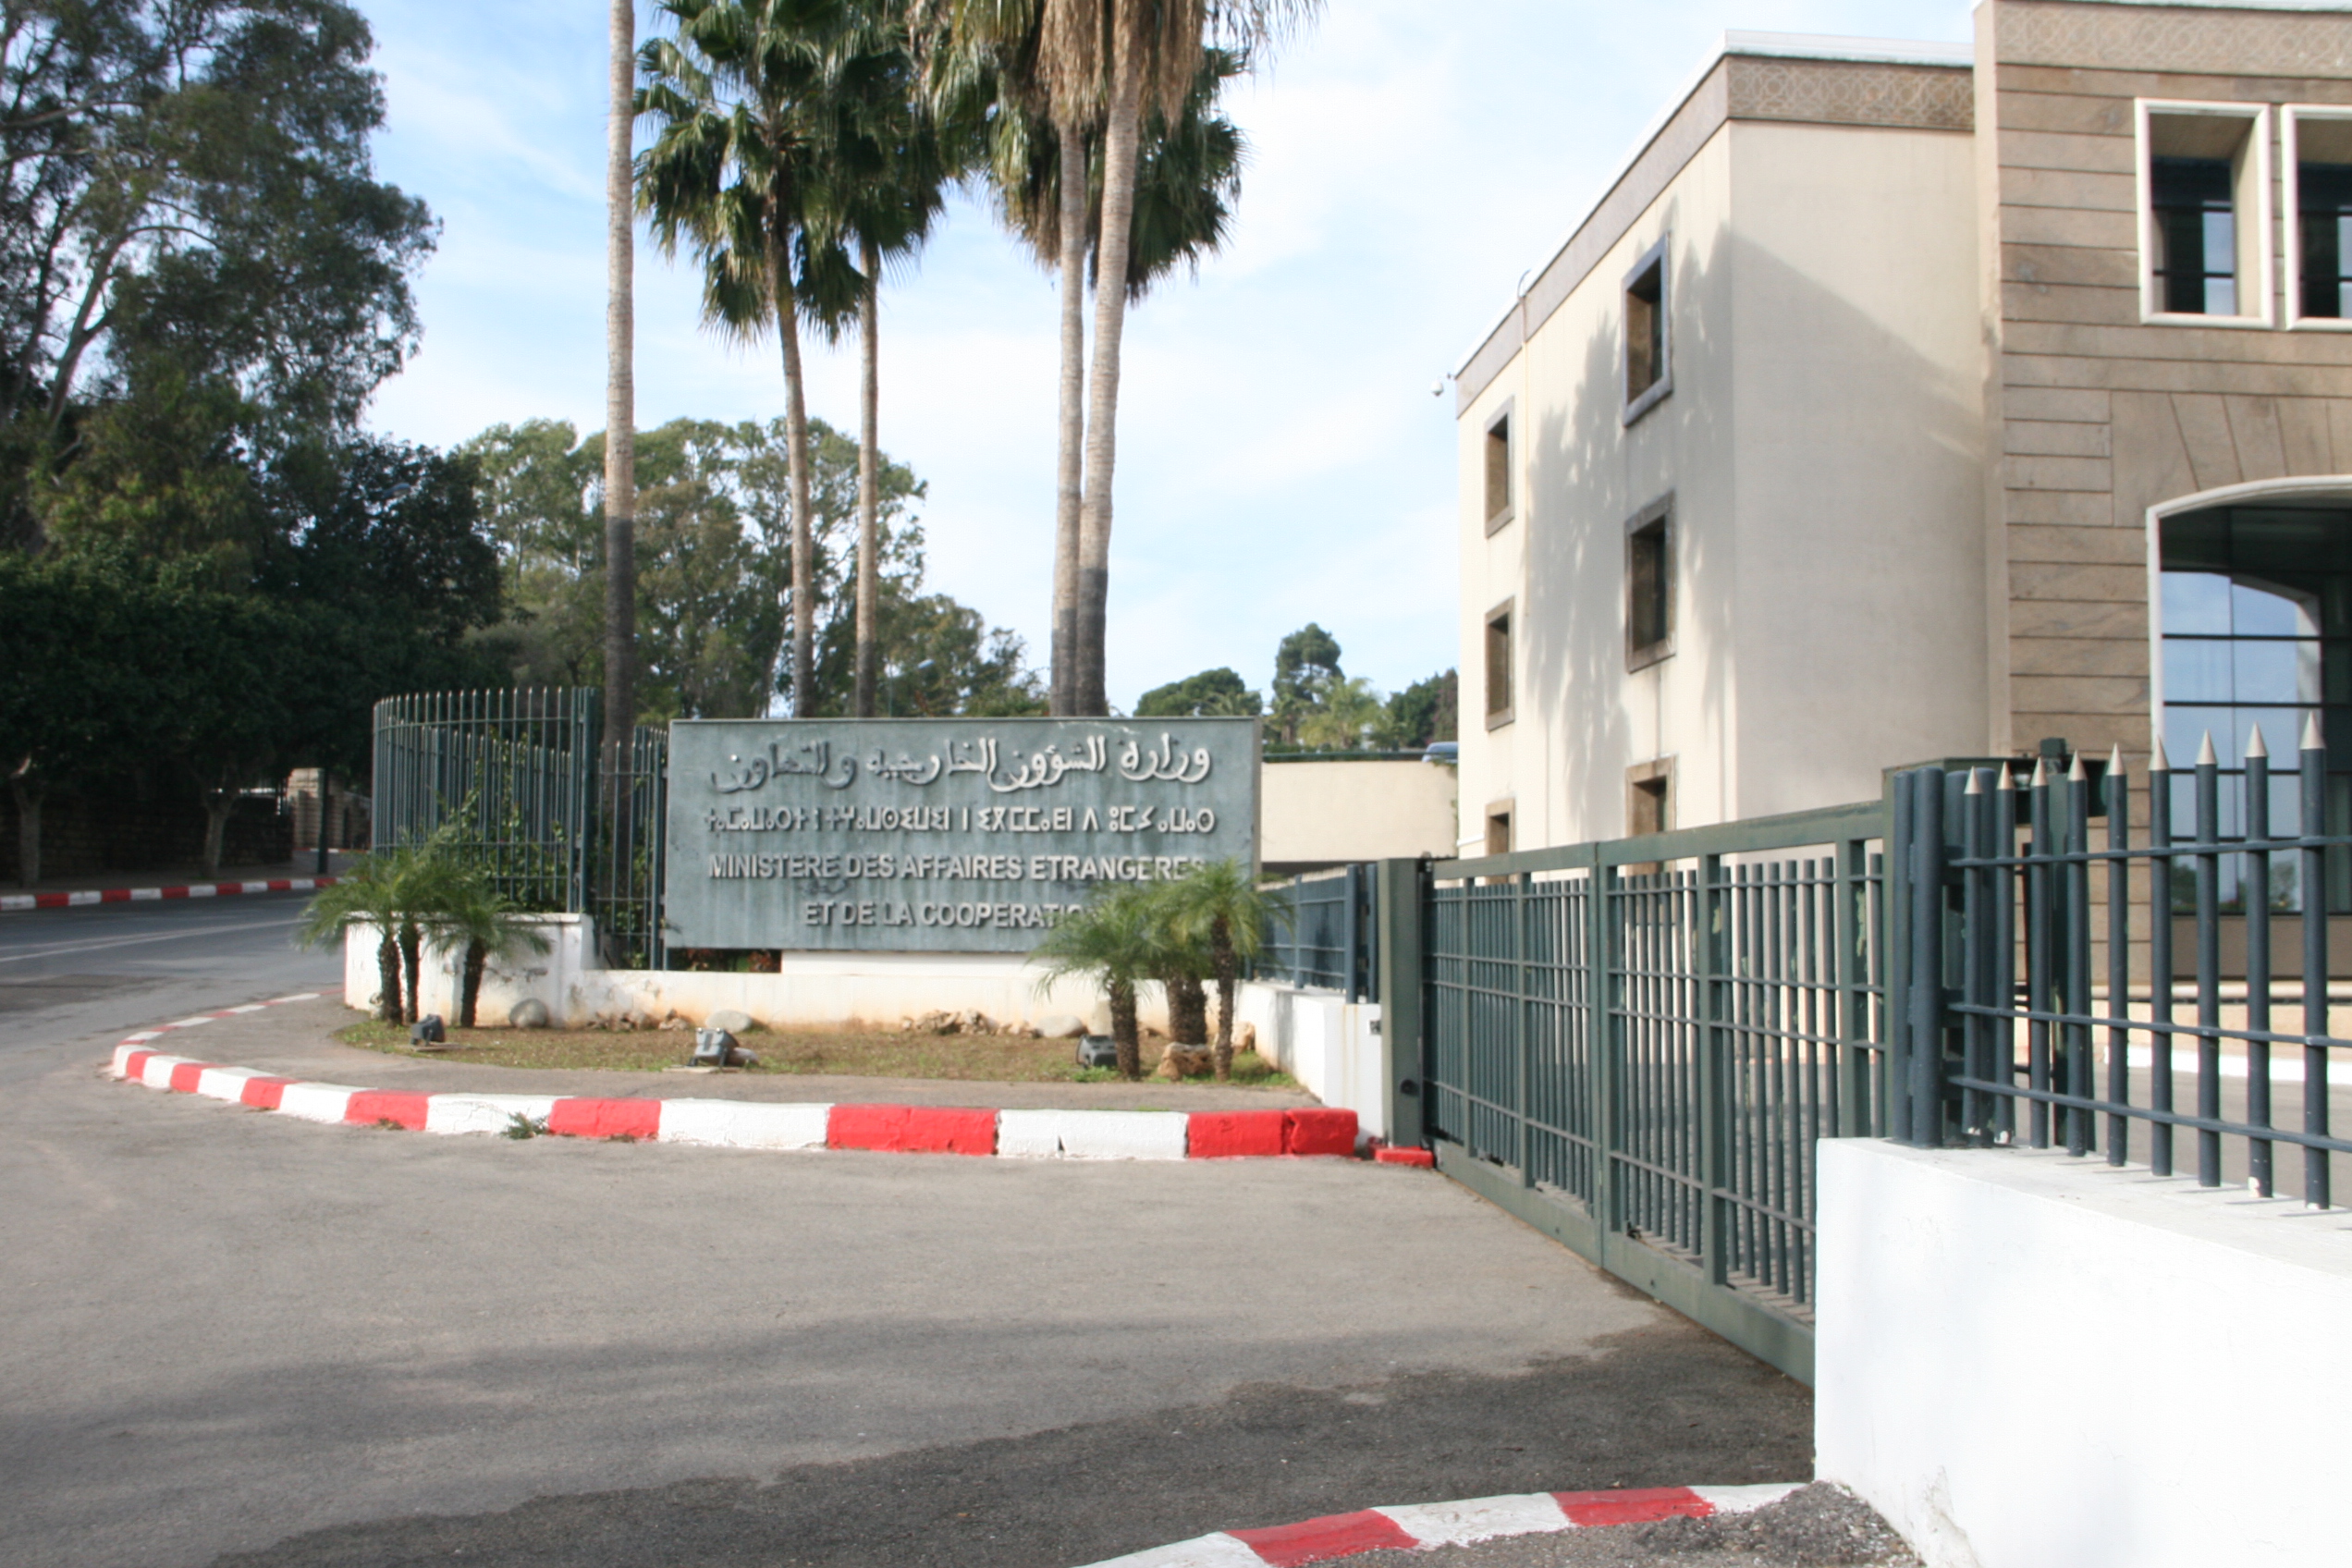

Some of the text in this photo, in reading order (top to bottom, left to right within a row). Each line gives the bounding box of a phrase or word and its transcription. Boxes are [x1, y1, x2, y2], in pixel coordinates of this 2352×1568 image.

[711, 741, 858, 793] والتعاون
[986, 735, 1106, 792] الشؤون
[1119, 732, 1210, 784] وزارة
[708, 853, 839, 878] MINISTERE
[845, 854, 896, 879] DES
[901, 854, 1023, 880] AFFAIRES
[805, 902, 837, 925] ET
[841, 902, 877, 925] DE
[882, 902, 917, 925] LA
